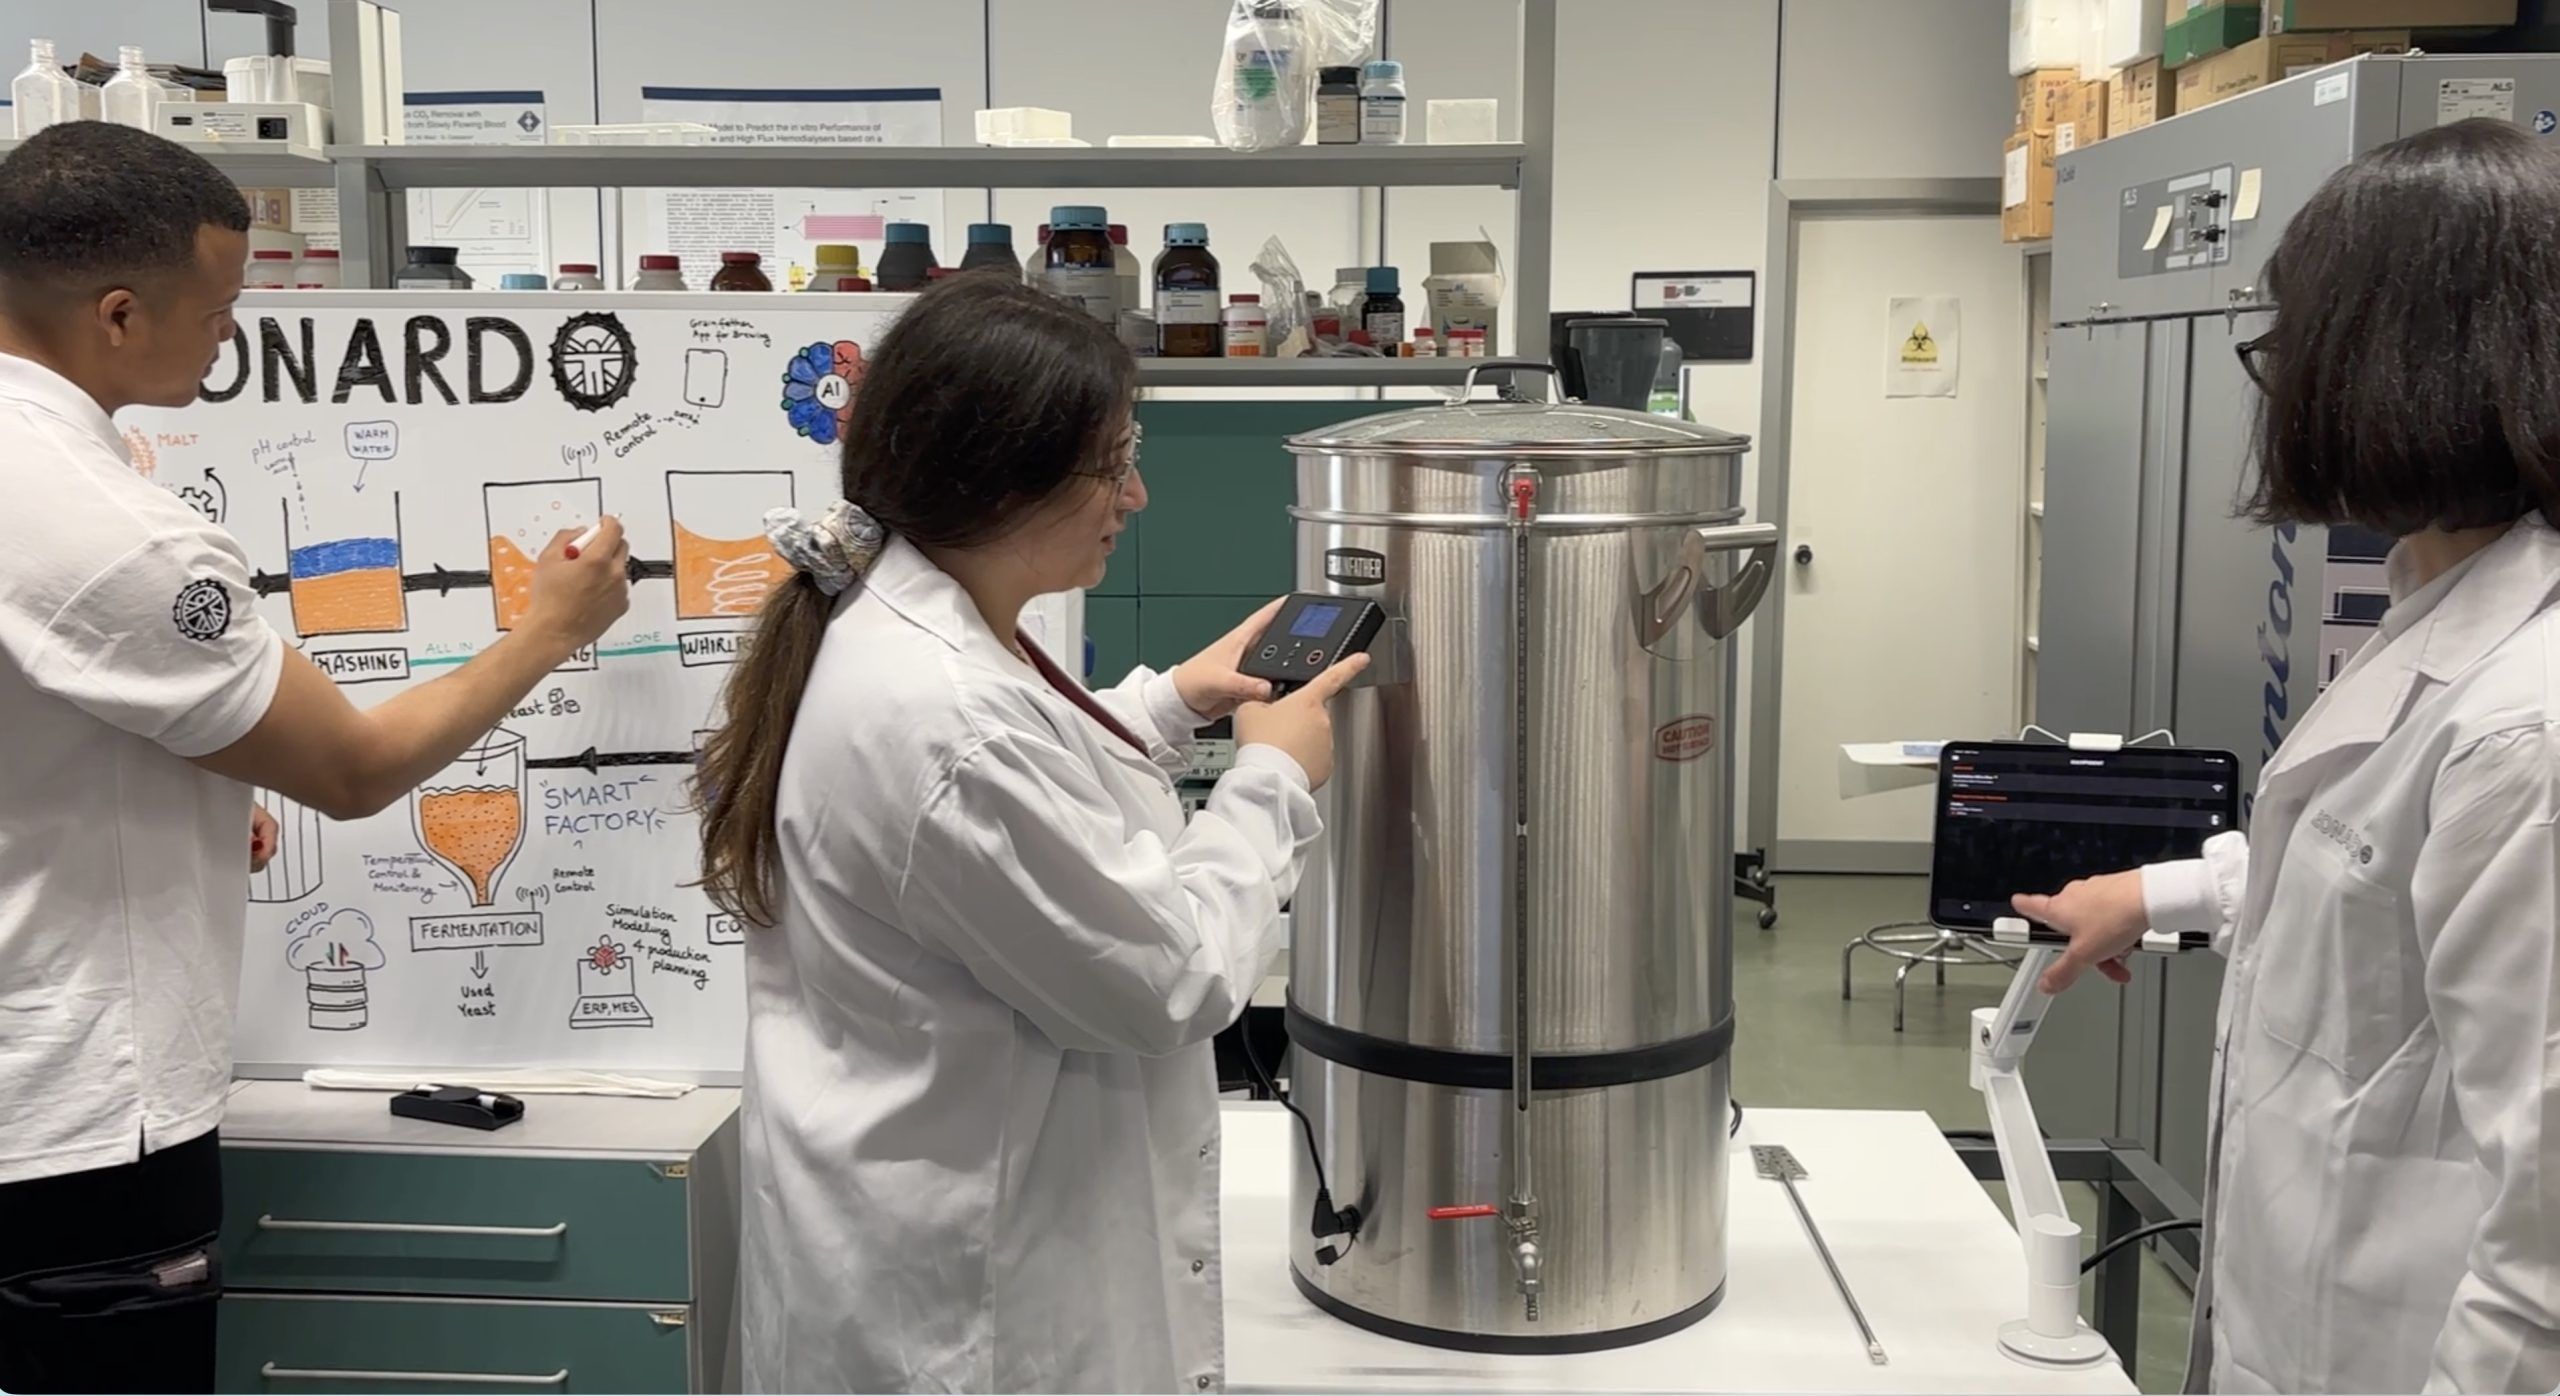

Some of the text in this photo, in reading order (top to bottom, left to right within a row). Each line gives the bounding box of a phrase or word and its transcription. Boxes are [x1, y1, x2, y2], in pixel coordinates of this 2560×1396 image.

[431, 110, 464, 118] Removal
[467, 110, 482, 118] with
[427, 121, 450, 131] Slowly
[453, 120, 482, 130] Flowing
[484, 120, 506, 128] Blood
[746, 123, 774, 131] Predict
[776, 123, 789, 131] the
[801, 123, 818, 131] vitro
[820, 123, 870, 131] Performance
[719, 134, 734, 142] and
[737, 134, 754, 144] High
[757, 134, 774, 142] Flux
[777, 134, 836, 144] Hemodialysers
[838, 134, 862, 142] based
[821, 381, 840, 398] AI
[354, 429, 389, 439] WARM
[603, 412, 653, 446] Remote
[157, 434, 199, 447] MALT
[615, 424, 657, 458] Control
[252, 439, 272, 465] pH
[351, 445, 391, 454] WATER
[425, 642, 450, 655] ALL
[503, 698, 545, 720] east
[1663, 722, 1711, 743] CAUTION
[545, 807, 657, 836] FACTORY
[368, 869, 409, 879] Control
[553, 865, 595, 879] Remote
[372, 883, 438, 904] Monitoring
[555, 880, 595, 893] Control
[286, 902, 329, 935] CLOUD
[605, 903, 678, 923] Simulation
[421, 920, 538, 940] FERMENTATION
[647, 945, 712, 963] production
[652, 959, 710, 991] planning
[461, 983, 495, 998] Used
[457, 1002, 496, 1017] Yeast
